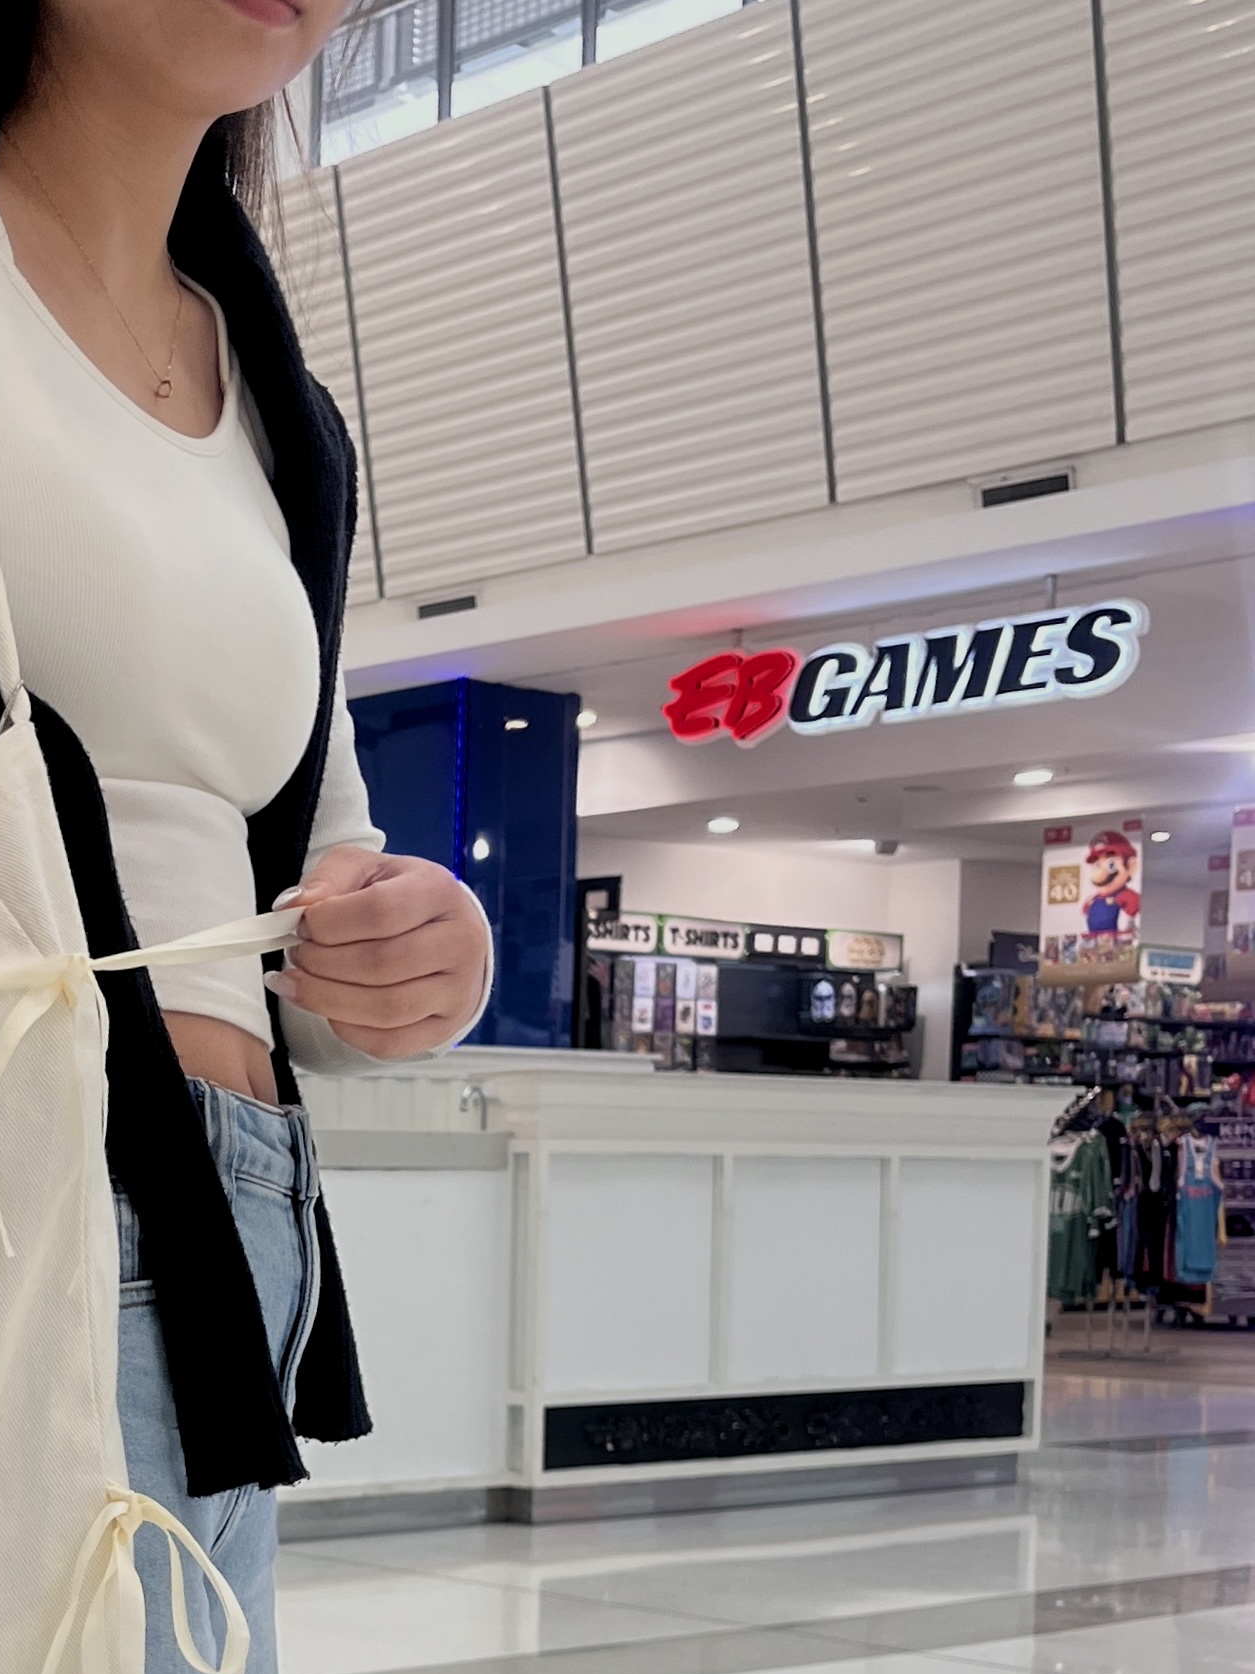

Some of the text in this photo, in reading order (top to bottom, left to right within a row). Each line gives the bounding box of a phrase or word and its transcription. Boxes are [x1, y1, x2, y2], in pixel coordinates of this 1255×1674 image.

[663, 605, 1136, 742] EB GAMES
[588, 920, 651, 943] SHIRTS
[671, 926, 740, 949] T-SHIRTS
